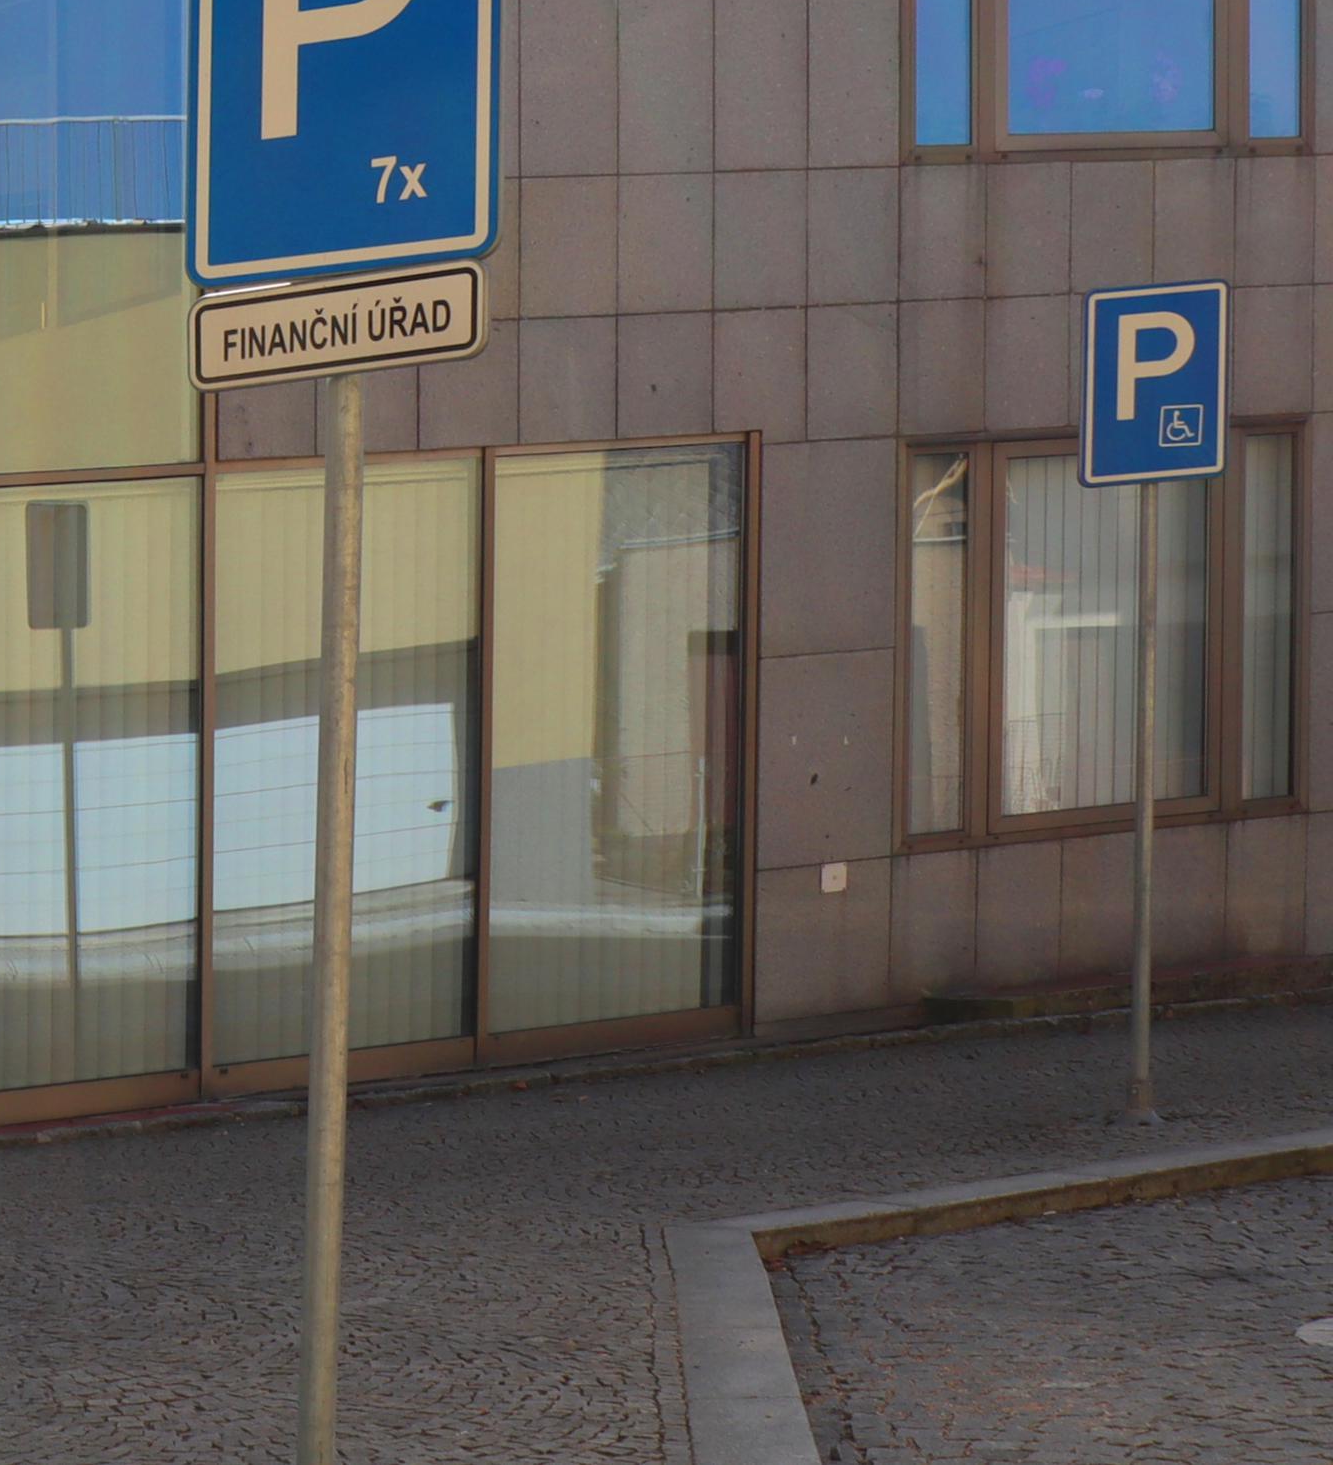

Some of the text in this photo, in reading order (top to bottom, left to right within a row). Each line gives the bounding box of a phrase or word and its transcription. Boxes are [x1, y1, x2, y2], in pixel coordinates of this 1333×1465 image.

[371, 155, 428, 204] 7x
[223, 296, 451, 362] FINANČNÍ ÚŘAD
[1116, 311, 1196, 421] P
